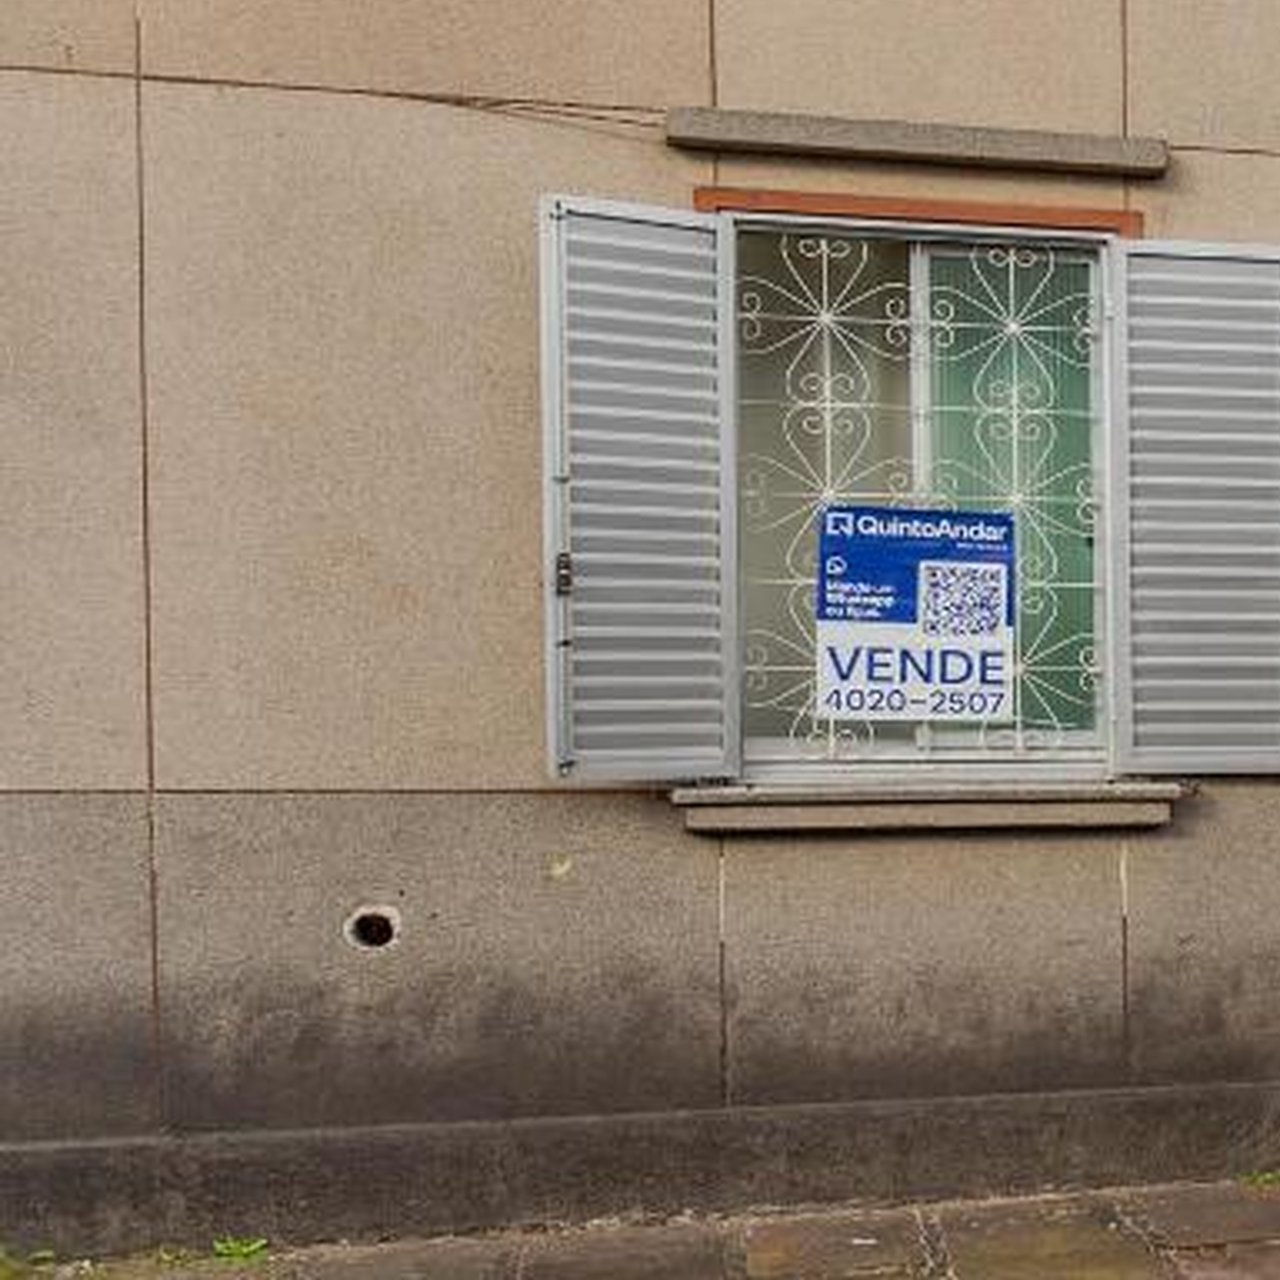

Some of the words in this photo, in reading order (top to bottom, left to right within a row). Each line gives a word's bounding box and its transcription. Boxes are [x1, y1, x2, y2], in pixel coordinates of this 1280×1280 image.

[857, 515, 1008, 541] QuintoAndar
[827, 646, 1005, 685] VENDE
[825, 688, 1005, 715] 4020-2507
